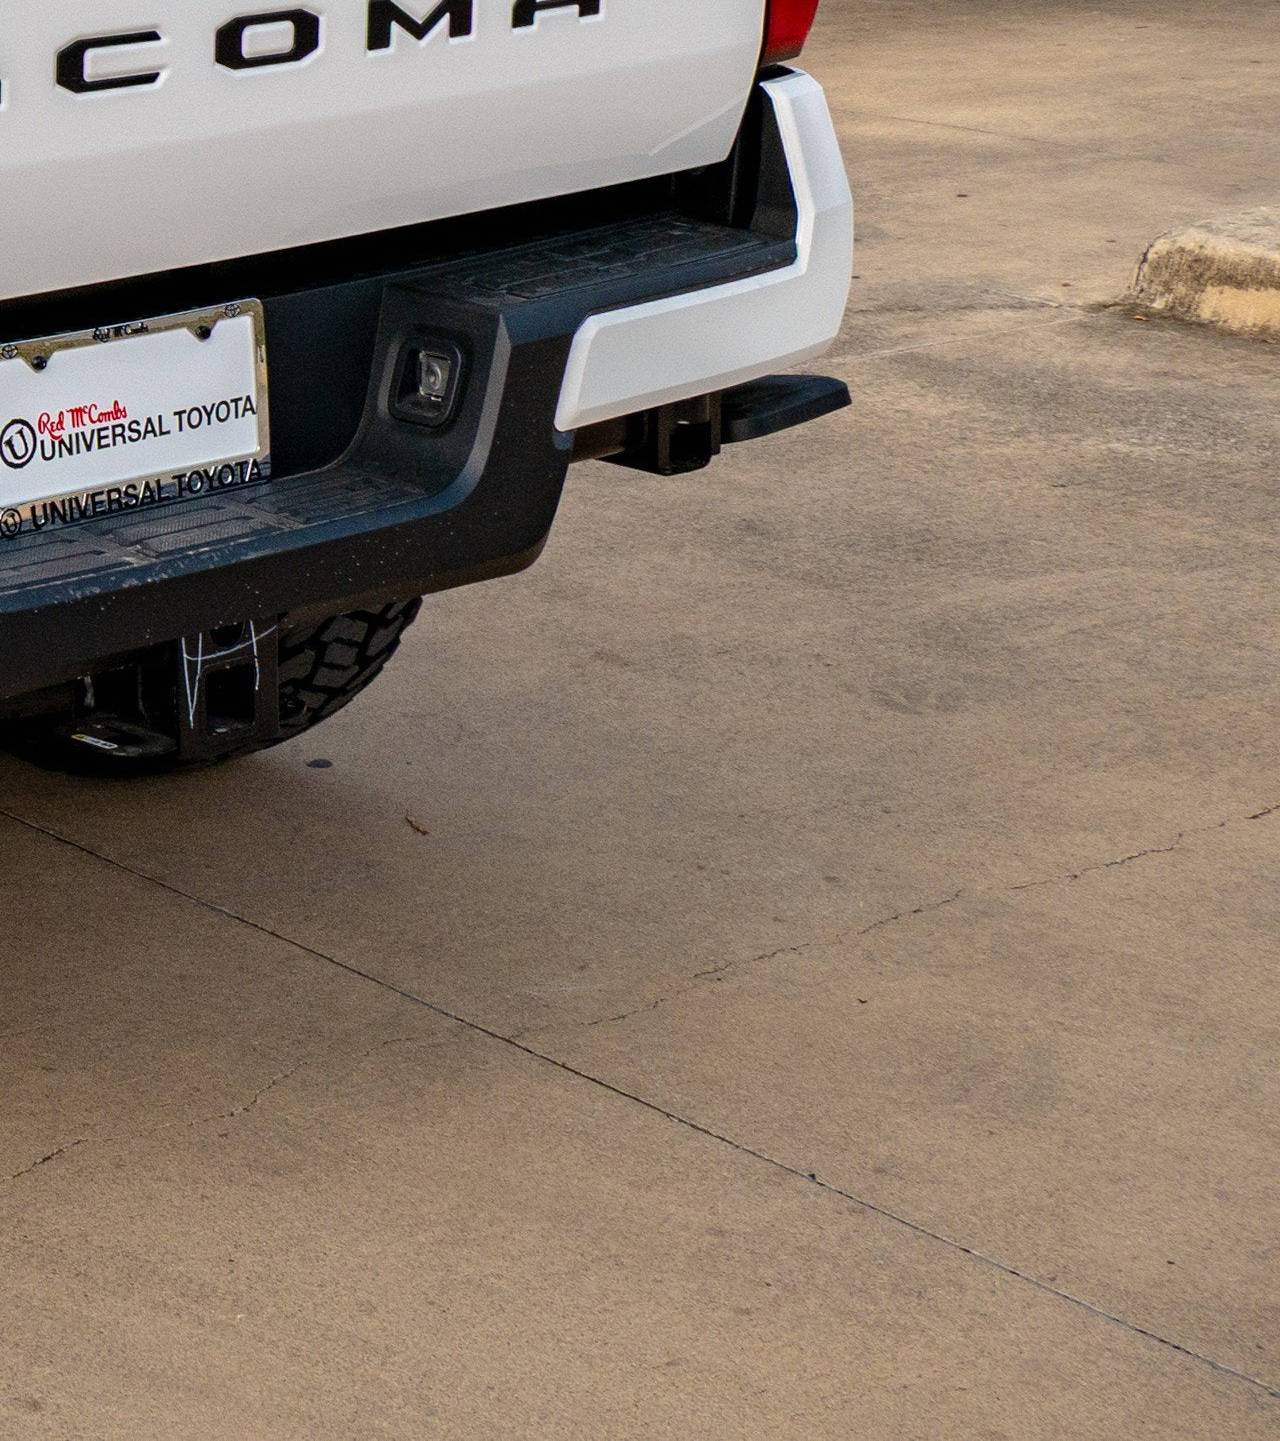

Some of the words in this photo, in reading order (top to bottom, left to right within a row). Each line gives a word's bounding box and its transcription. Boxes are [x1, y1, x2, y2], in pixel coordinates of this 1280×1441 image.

[37, 411, 65, 441] Red
[68, 400, 127, 429] McCombs
[39, 415, 172, 462] UNIVERSAL
[173, 395, 257, 436] TOYOTA
[31, 478, 172, 530] UNIVERSAL
[172, 458, 262, 496] TOYOTA
